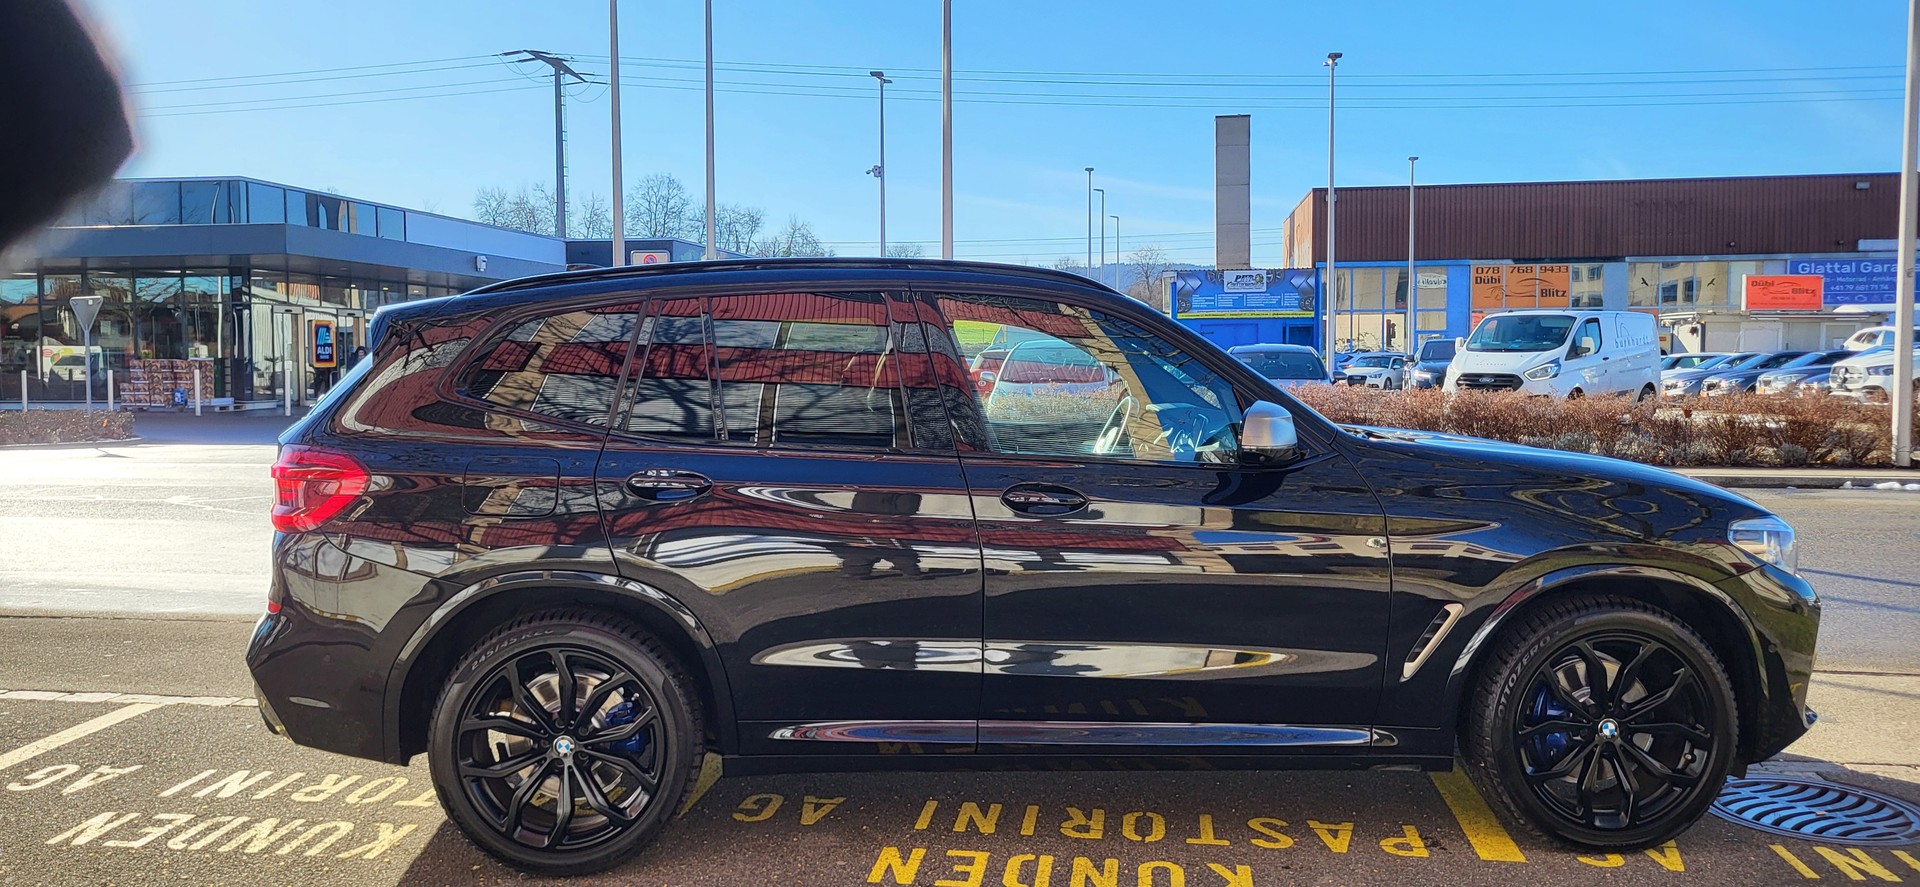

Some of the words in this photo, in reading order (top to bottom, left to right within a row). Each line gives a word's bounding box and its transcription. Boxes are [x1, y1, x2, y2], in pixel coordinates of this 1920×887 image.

[1475, 266, 1500, 275] 078
[1509, 266, 1533, 274] 768
[1540, 265, 1569, 273] 9433
[1798, 262, 1856, 274] Glattal
[1860, 261, 1920, 273] Gara
[1474, 276, 1501, 285] Dübi
[1540, 288, 1567, 298] Blitz
[1791, 287, 1816, 296] Blitz
[317, 346, 332, 354] ALDI
[6, 764, 144, 795] AG
[731, 793, 847, 826] AG
[45, 812, 418, 859] KUNDEN
[914, 800, 1430, 858] PASTORINI
[866, 846, 1254, 887] KUNDEN
